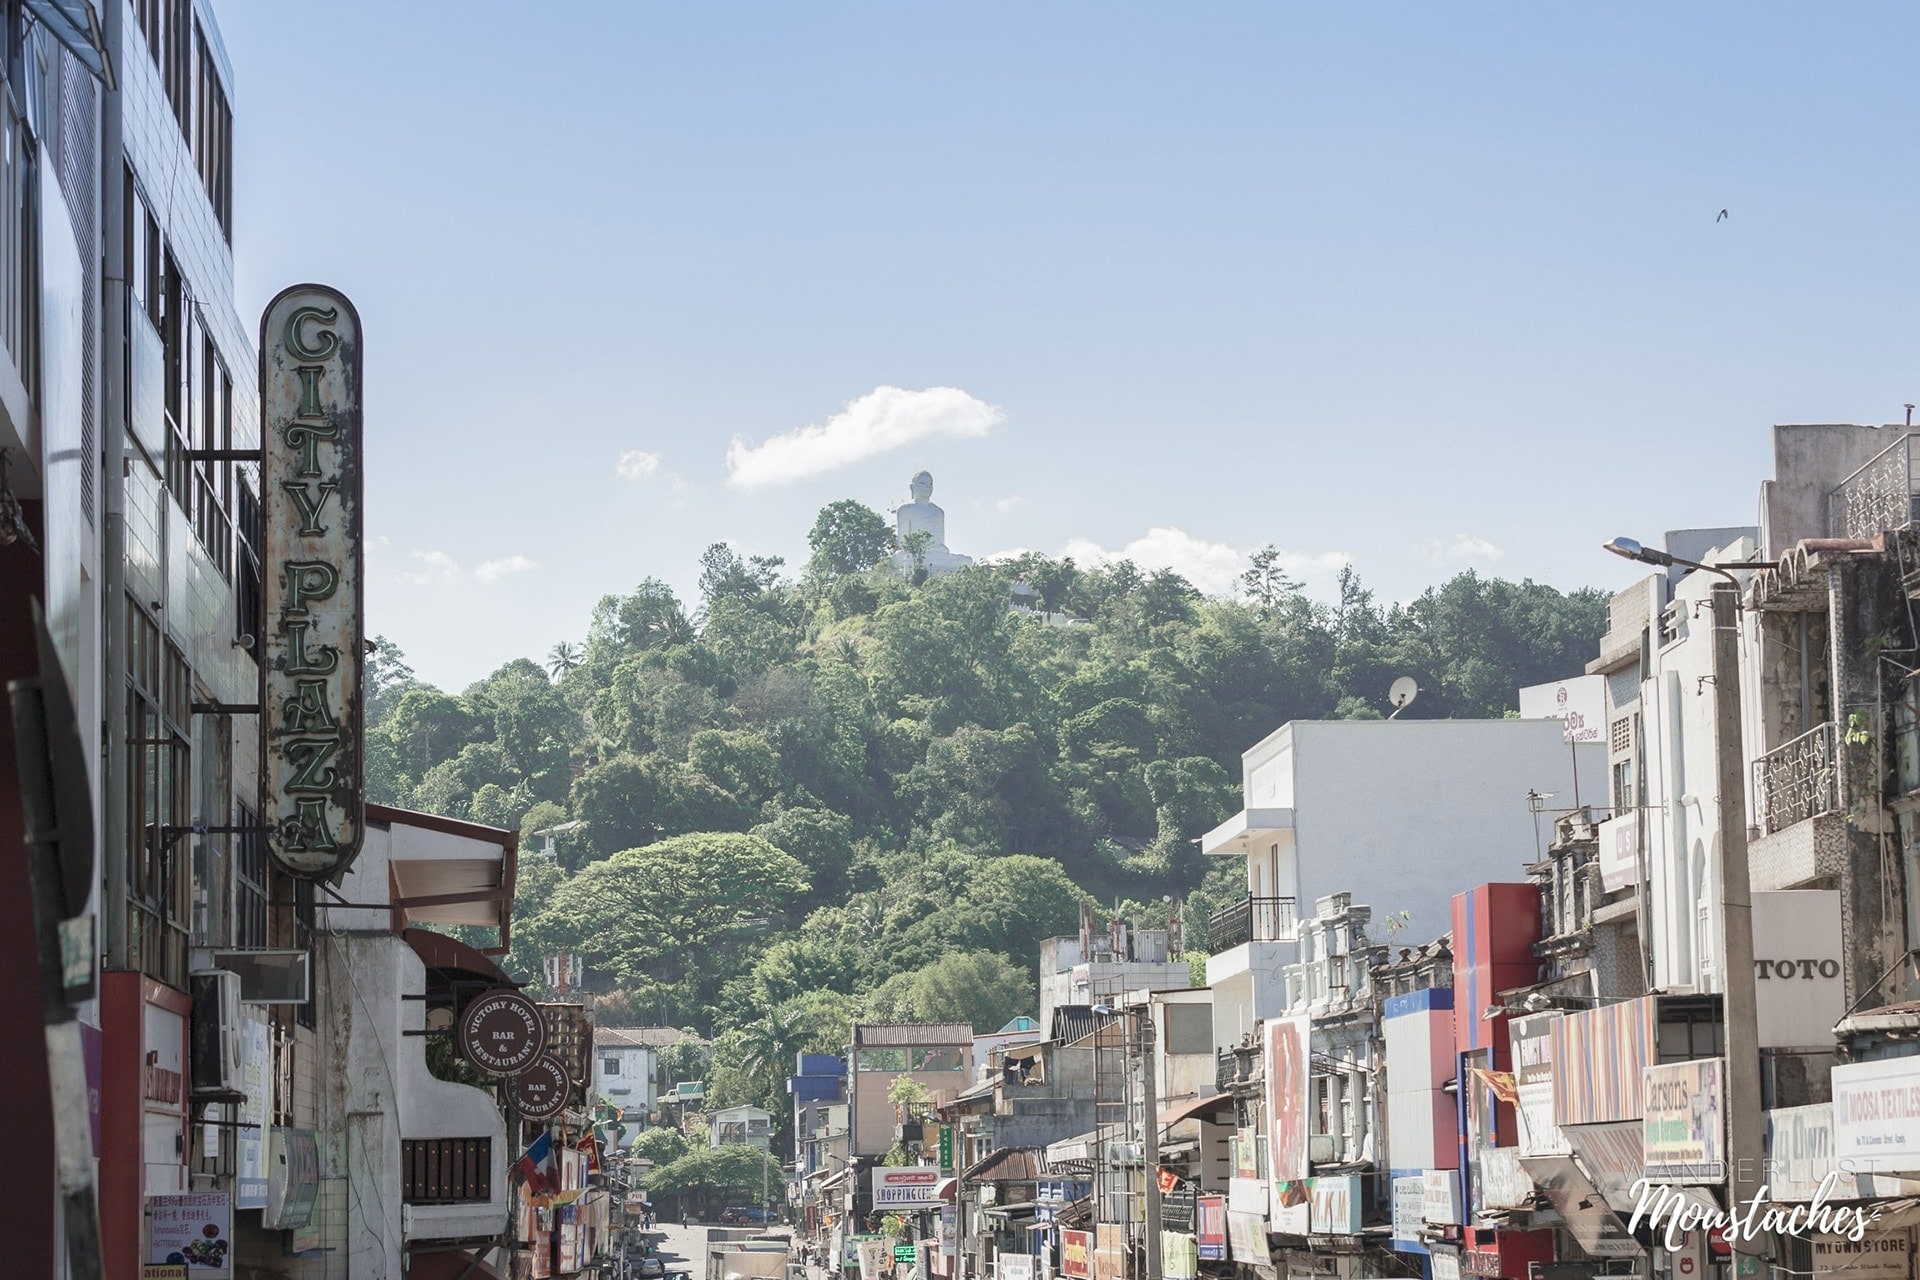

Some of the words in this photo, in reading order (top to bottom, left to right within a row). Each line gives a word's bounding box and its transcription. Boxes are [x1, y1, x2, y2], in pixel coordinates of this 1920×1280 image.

[284, 305, 340, 537] CITY
[282, 560, 340, 854] PLAZA
[1754, 959, 1840, 979] TOTO
[471, 1001, 507, 1034] VICTORY
[509, 1003, 536, 1034] HOTEL
[492, 1031, 515, 1040] BAR
[498, 1044, 508, 1052] &
[471, 1039, 535, 1067] RESTAURANT
[528, 1083, 547, 1091] BAR
[542, 1061, 564, 1087] HOTEL
[519, 1090, 562, 1113] STAURANT
[1644, 1073, 1688, 1113] Carsons
[1850, 1090, 1880, 1122] MOOSA
[1881, 1086, 1920, 1119] TEXTILES
[877, 1188, 916, 1200] SHOPPING
